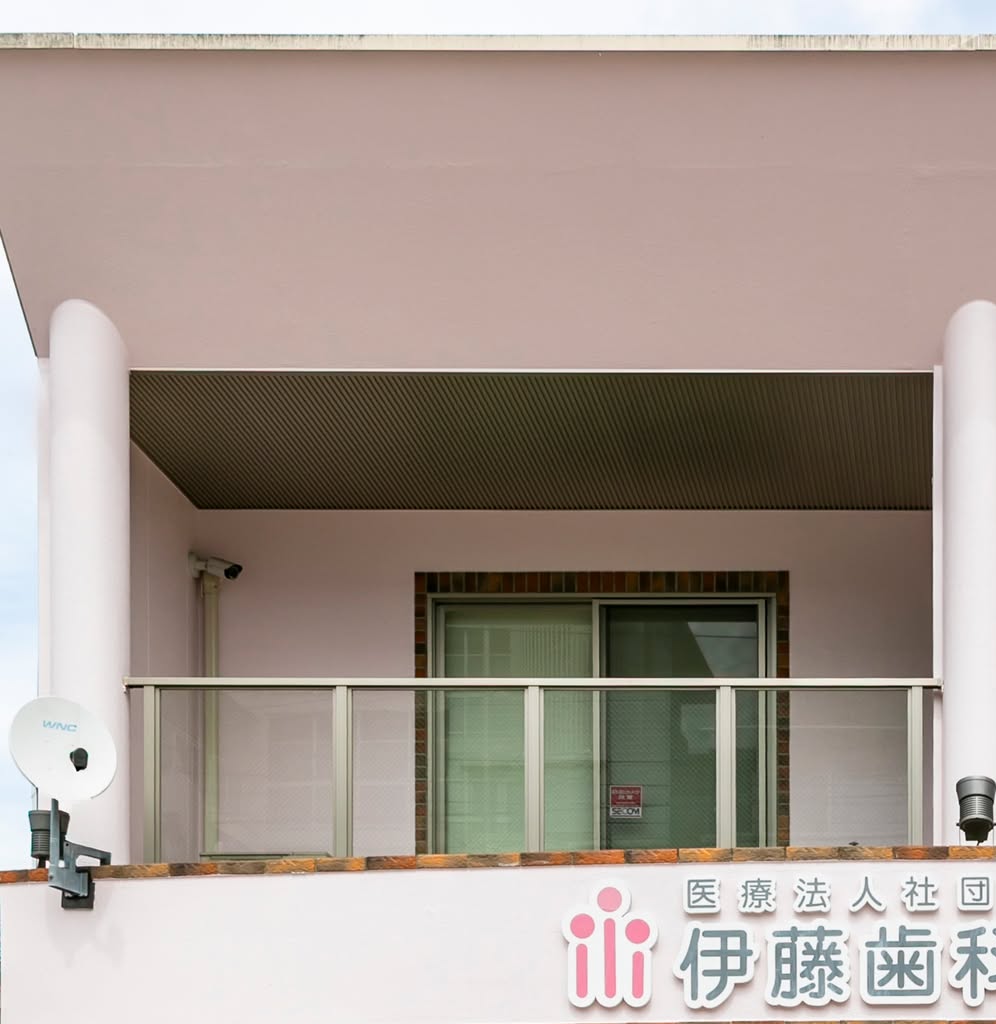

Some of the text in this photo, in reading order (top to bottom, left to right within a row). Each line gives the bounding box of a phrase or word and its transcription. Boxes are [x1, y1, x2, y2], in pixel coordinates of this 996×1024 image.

[42, 719, 77, 732] WNC
[685, 878, 992, 912] 医療法人社団
